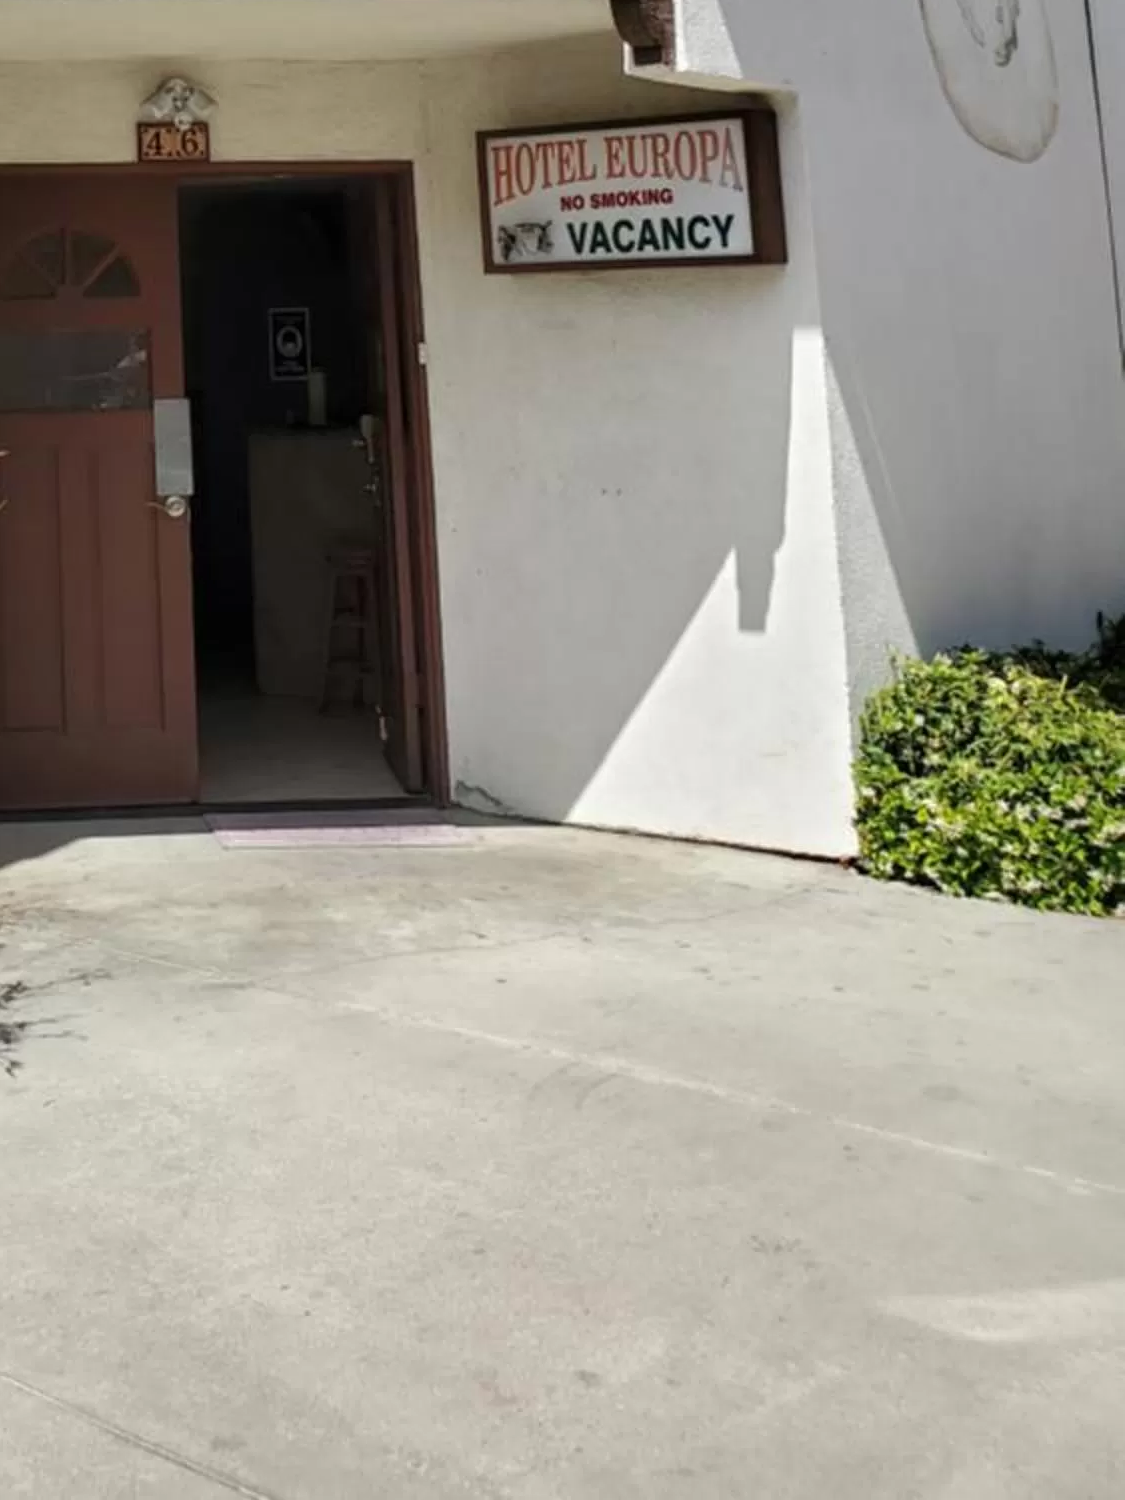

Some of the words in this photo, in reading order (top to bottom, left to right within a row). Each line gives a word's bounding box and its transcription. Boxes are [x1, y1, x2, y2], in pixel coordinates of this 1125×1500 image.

[491, 138, 596, 206] HOTEL
[604, 126, 743, 192] EUROPA
[560, 196, 584, 212] NO
[590, 188, 674, 209] SMOKING
[566, 214, 735, 254] VACANCY
